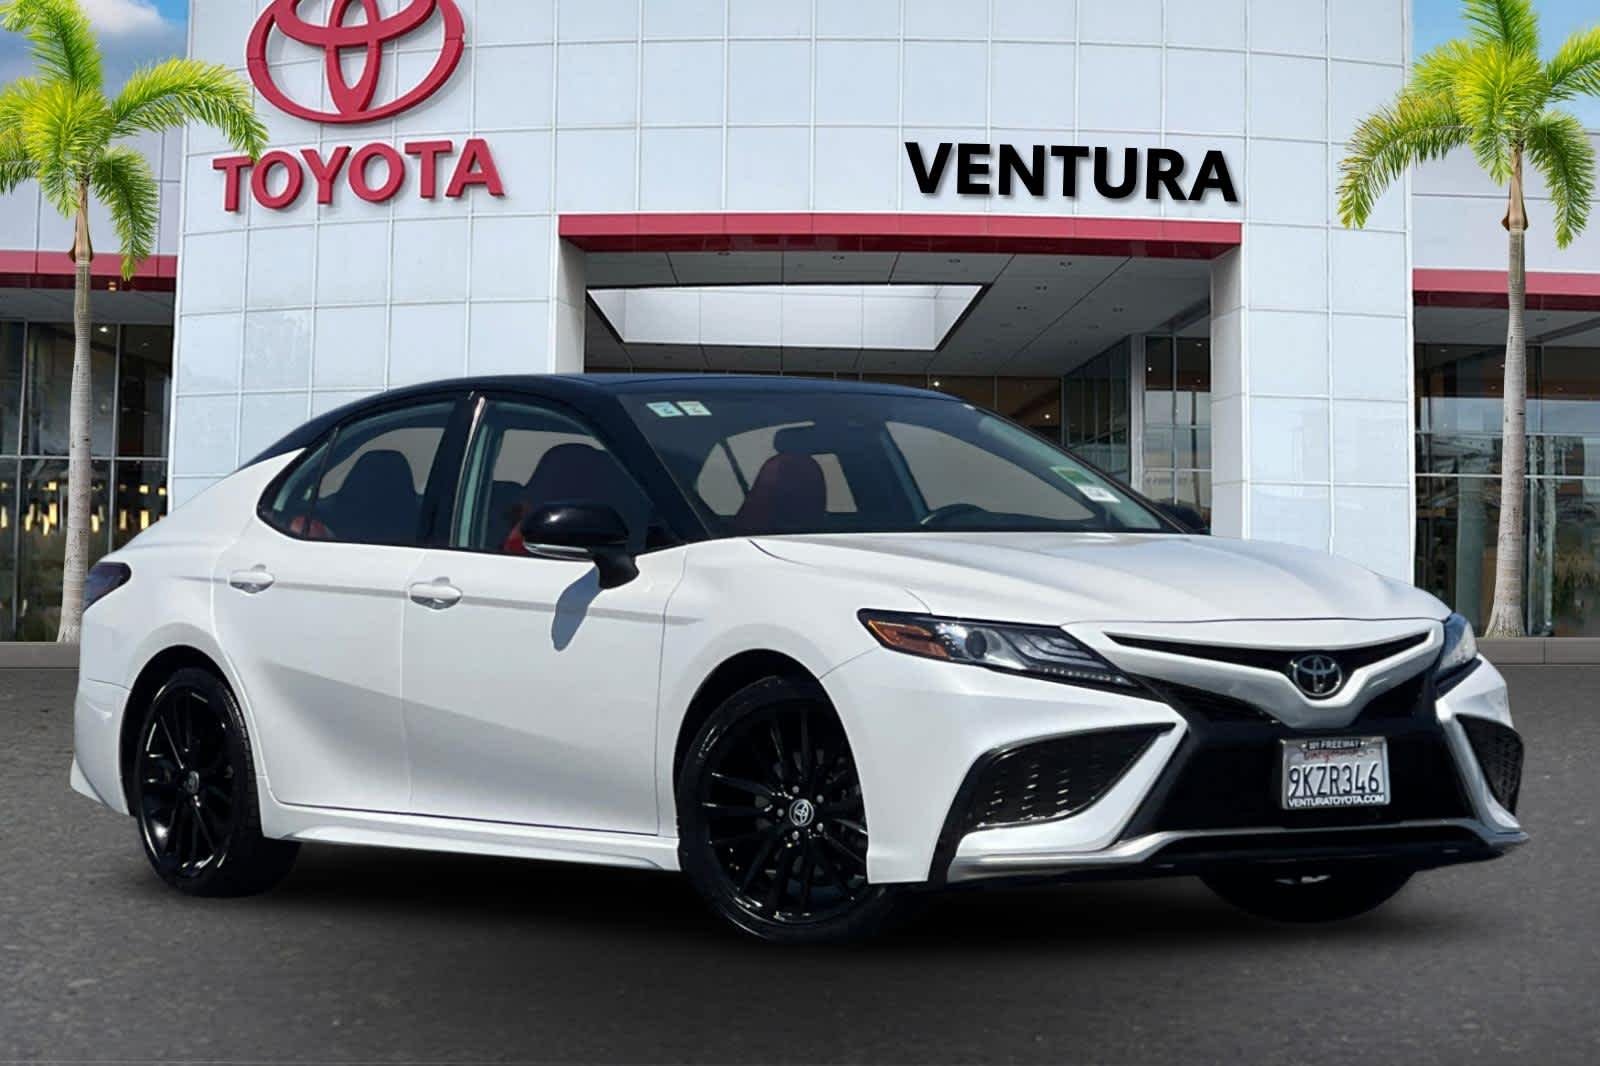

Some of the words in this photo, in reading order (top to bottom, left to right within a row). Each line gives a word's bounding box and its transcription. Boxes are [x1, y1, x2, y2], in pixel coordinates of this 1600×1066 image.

[212, 138, 505, 212] TOYOTA
[905, 142, 1239, 202] VENTURA
[1288, 795, 1384, 807] VENTURATOYOTA.COM
[1289, 763, 1380, 797] 9KZR346
